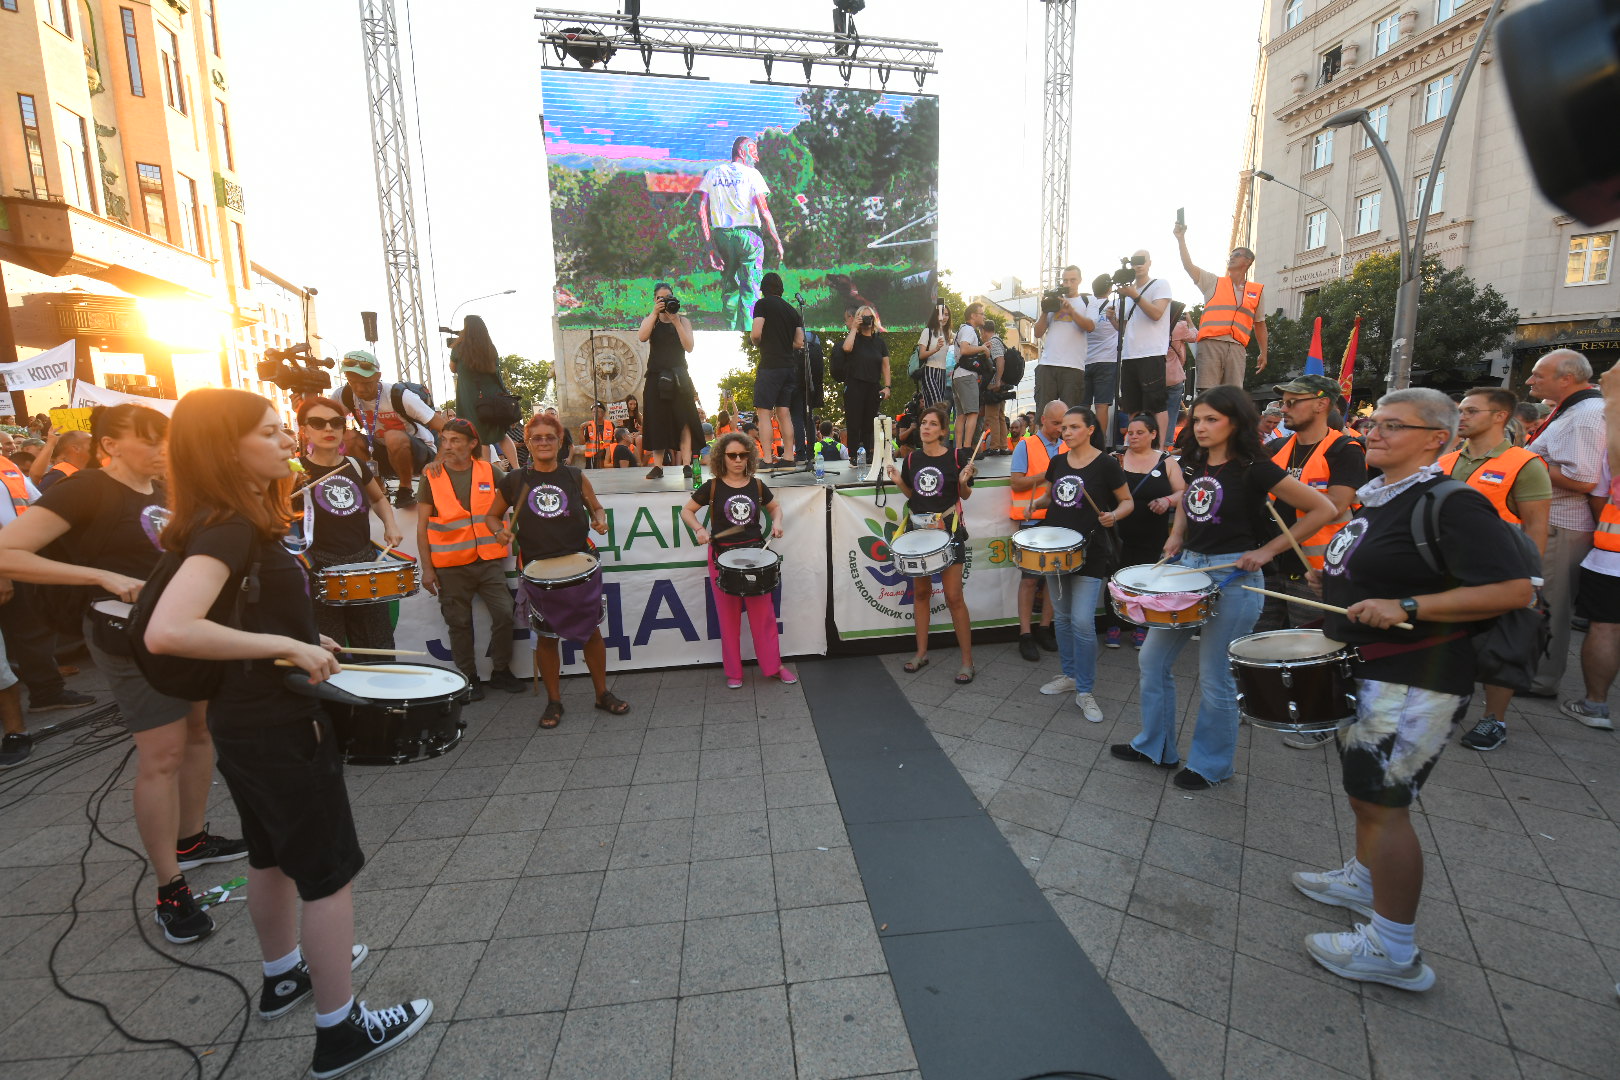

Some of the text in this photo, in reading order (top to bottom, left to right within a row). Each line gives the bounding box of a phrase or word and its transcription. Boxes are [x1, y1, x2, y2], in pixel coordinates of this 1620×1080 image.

[1303, 36, 1464, 126] ХОТЕЛ БАЛКАН
[848, 549, 860, 579] САВЕЗ
[854, 579, 903, 620] ЕКОЛОШКИХ
